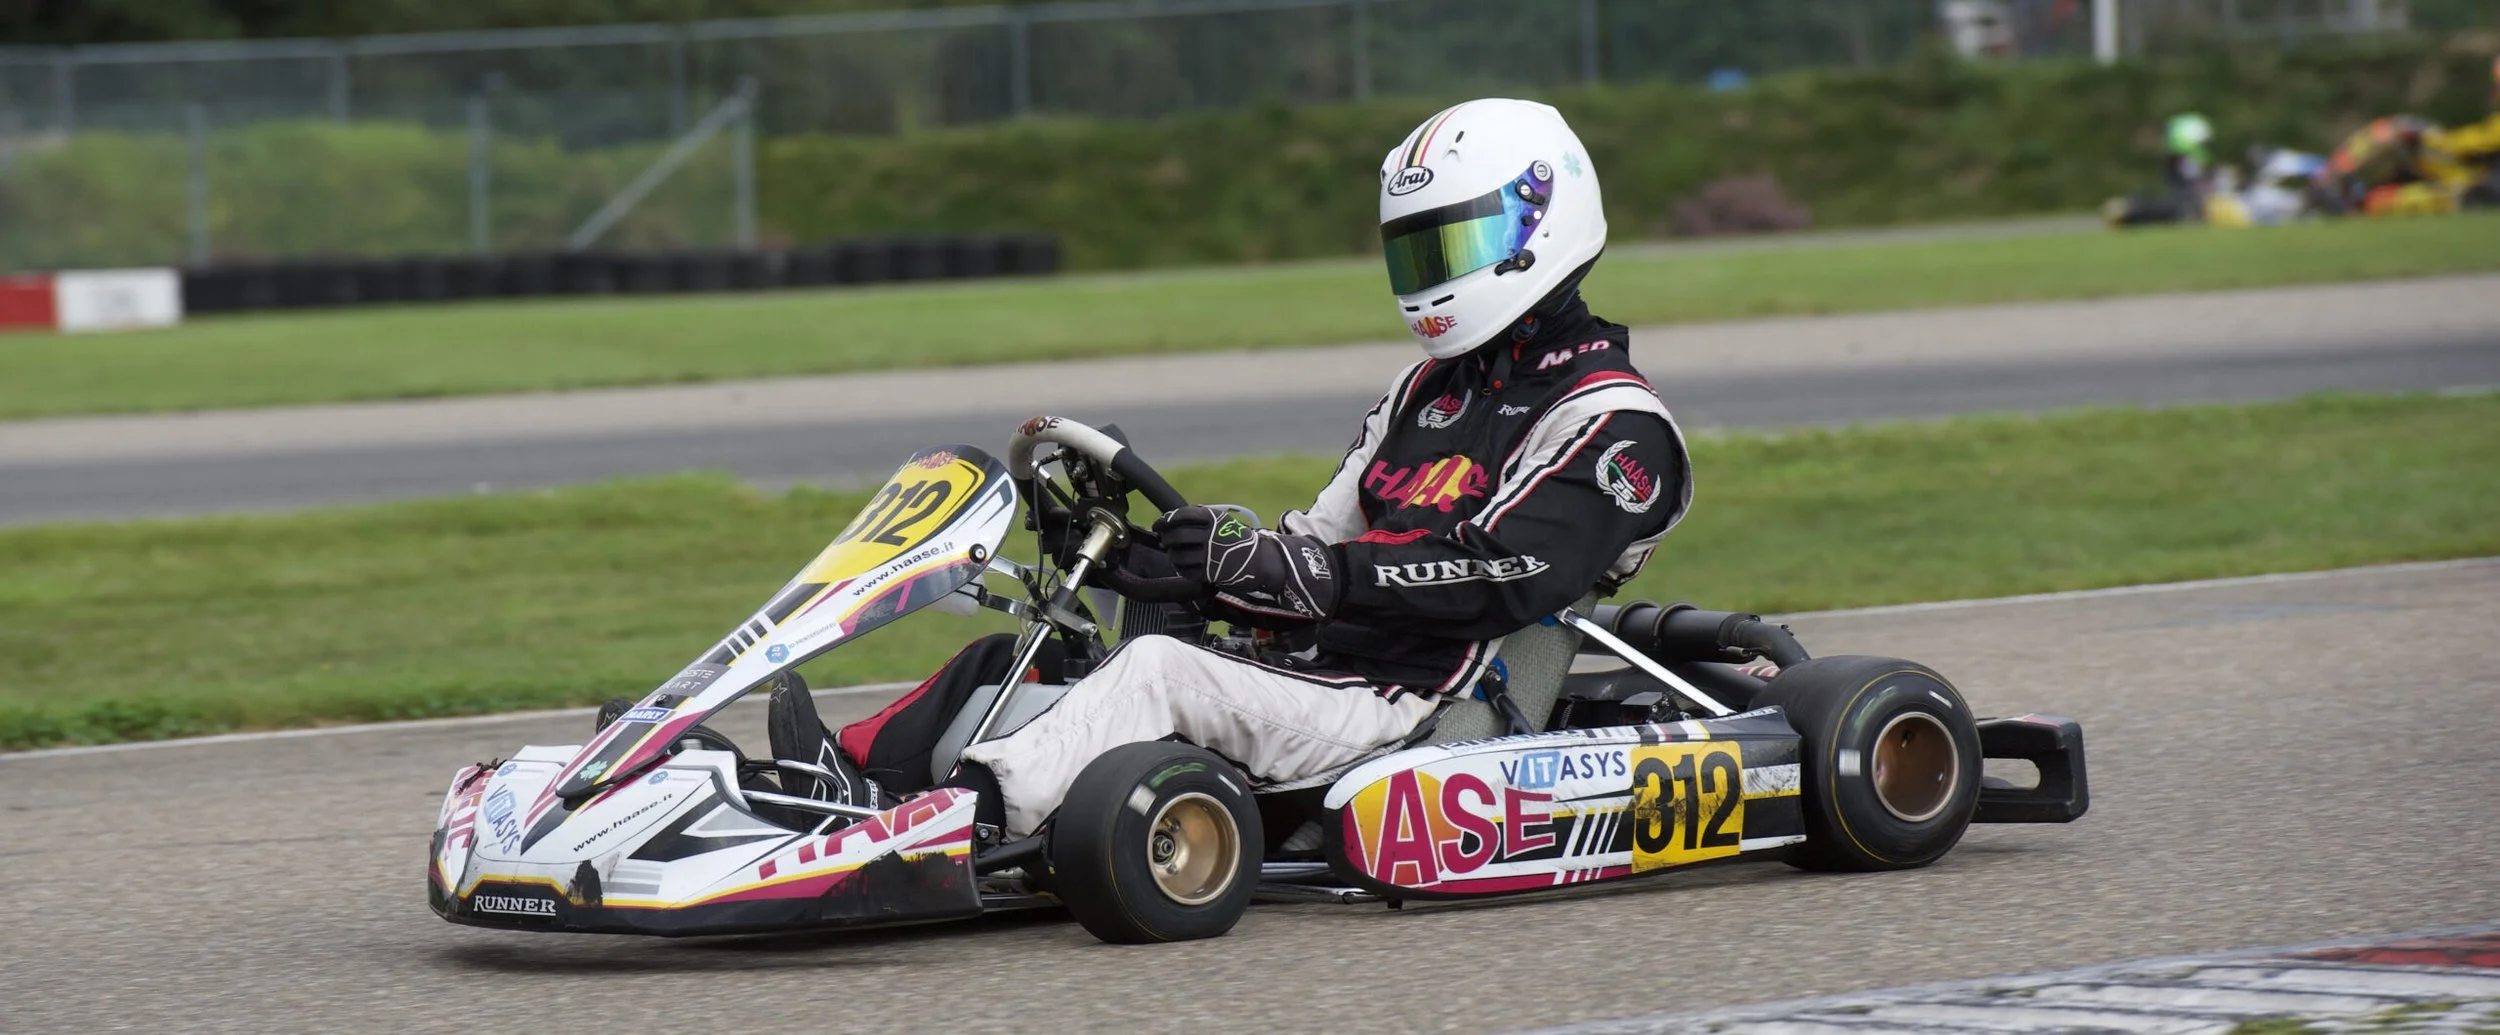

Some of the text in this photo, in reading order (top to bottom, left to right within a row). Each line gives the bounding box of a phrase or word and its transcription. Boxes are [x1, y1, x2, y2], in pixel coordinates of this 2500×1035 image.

[1389, 168, 1427, 191] Arai
[1410, 314, 1459, 339] HAASE
[1614, 452, 1653, 499] HAASE
[832, 479, 953, 547] 312
[852, 541, 954, 596] www.haase.it
[1373, 554, 1551, 588] RUNNER
[1499, 750, 1627, 786] VITASYS
[572, 793, 673, 853] www.haase.it
[1633, 750, 1741, 855] 312
[1343, 768, 1556, 888] ASE
[473, 893, 557, 917] RUNNER
